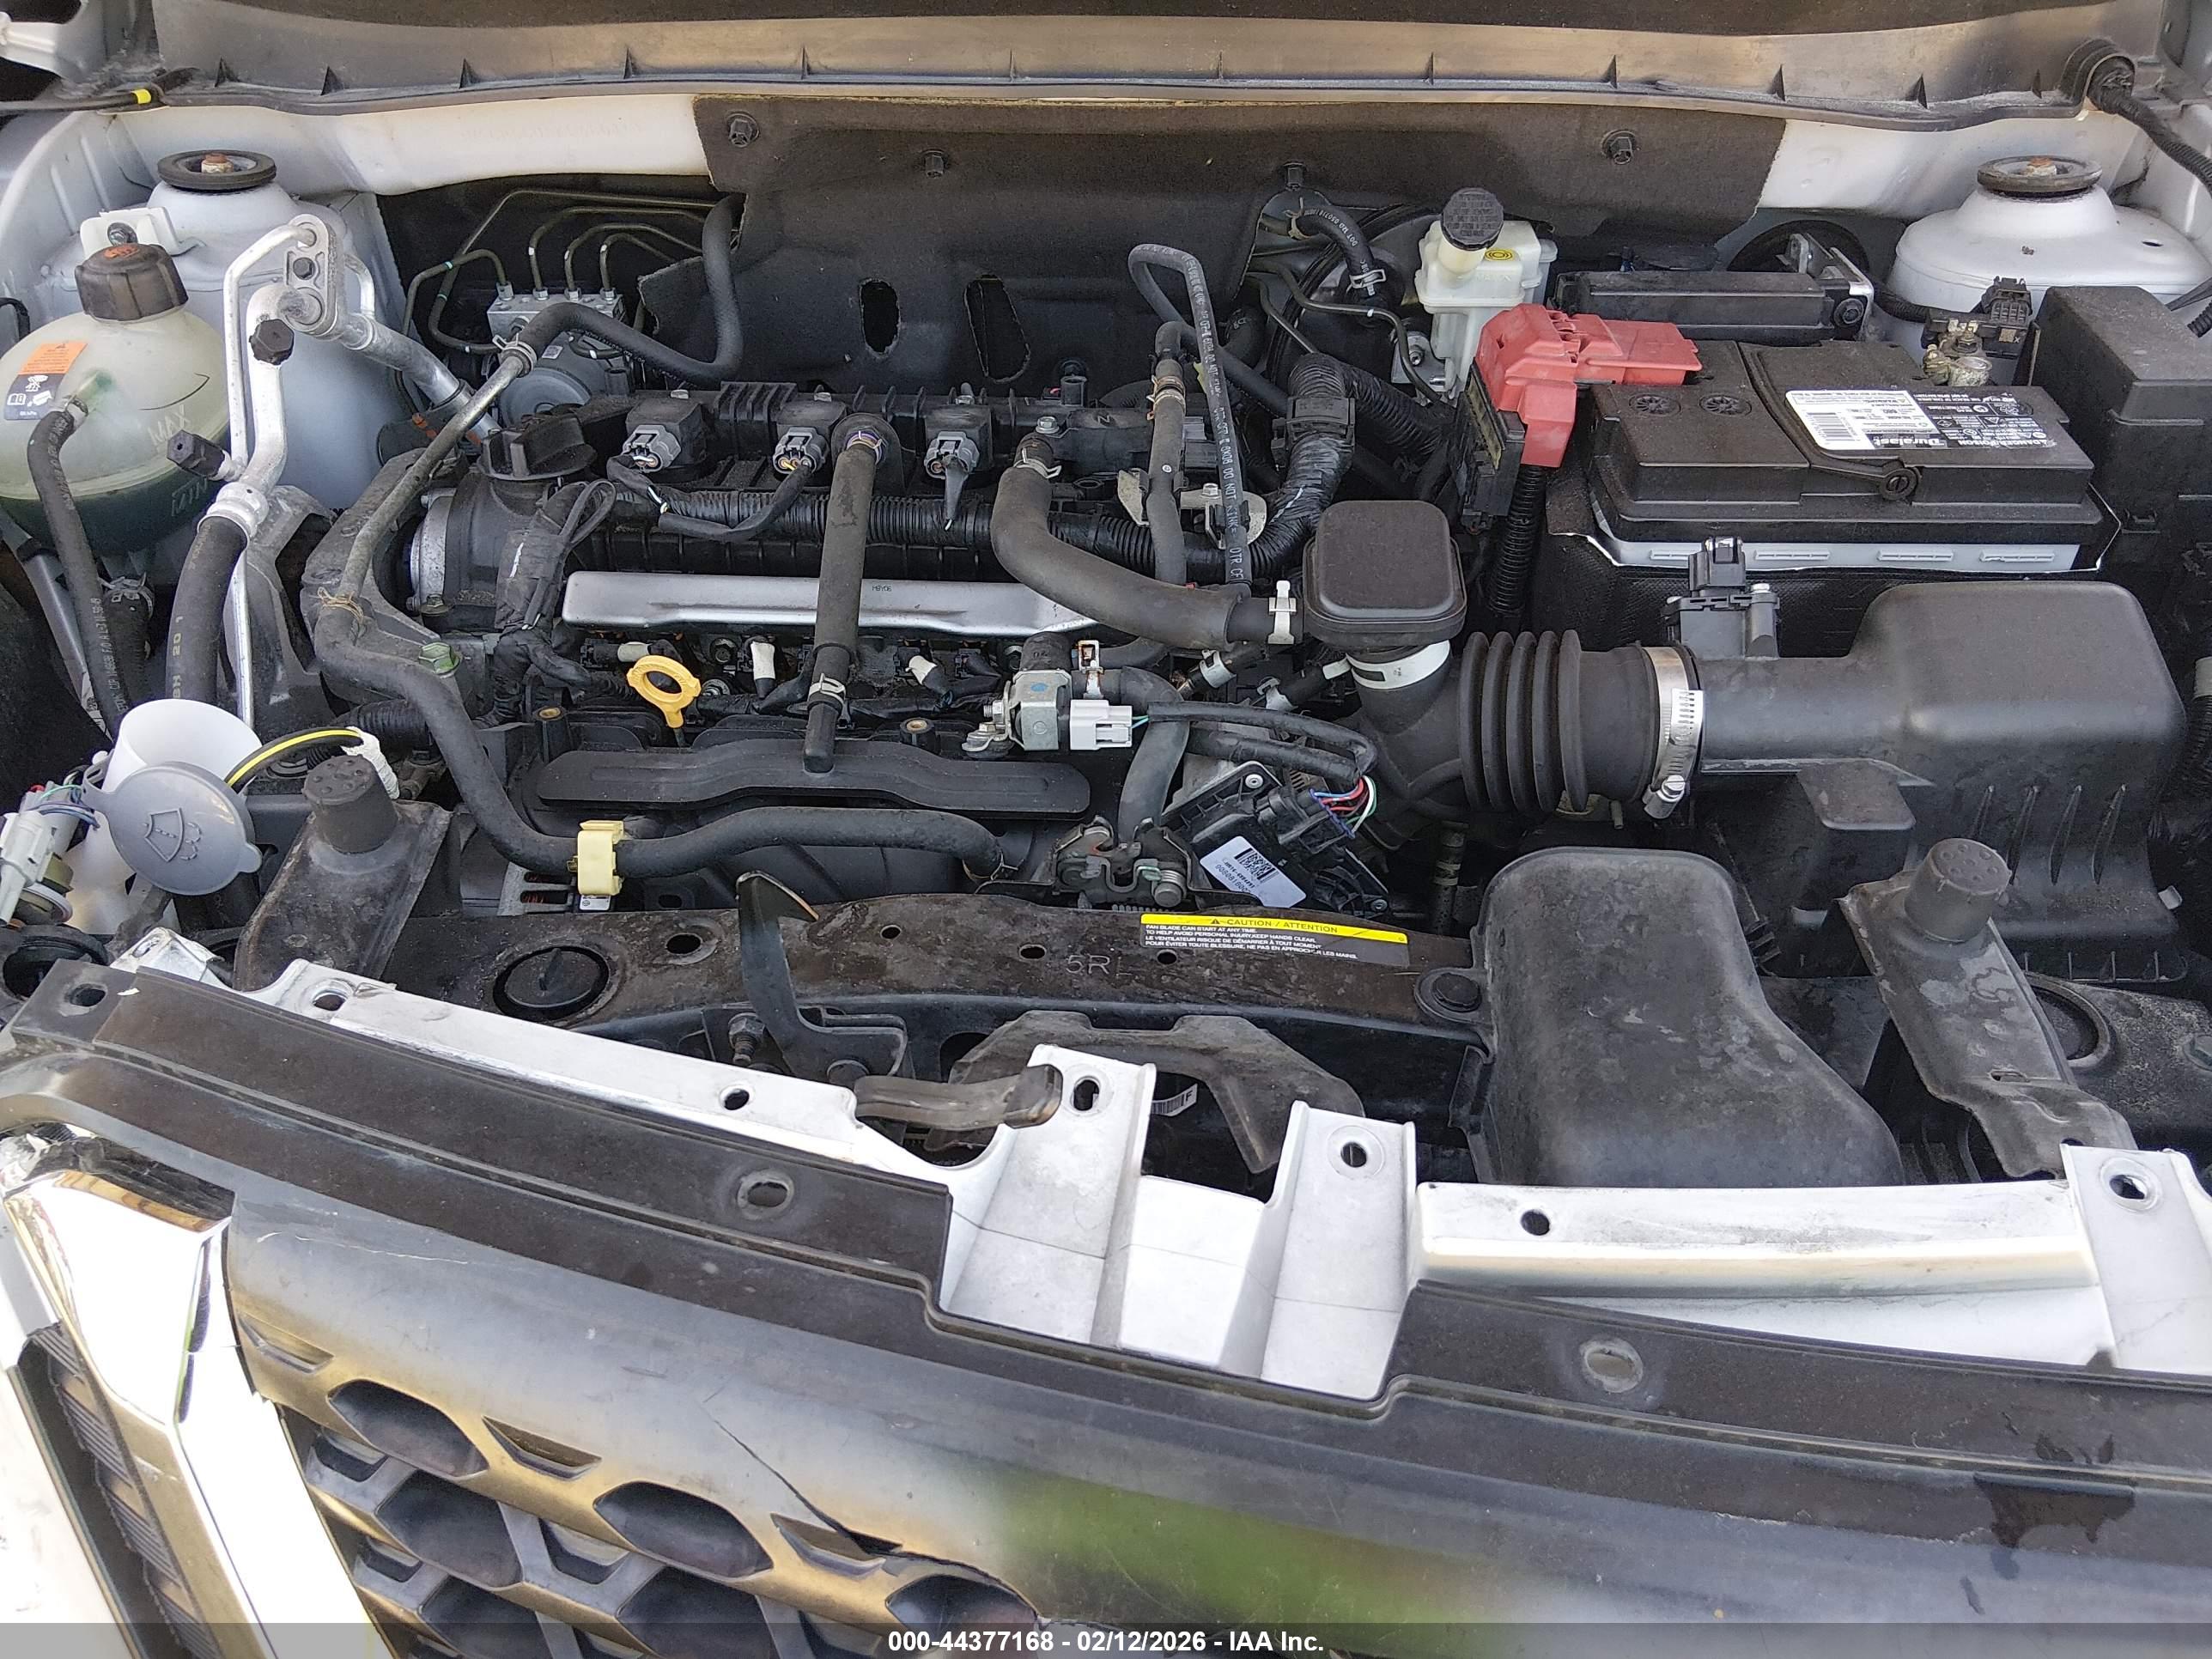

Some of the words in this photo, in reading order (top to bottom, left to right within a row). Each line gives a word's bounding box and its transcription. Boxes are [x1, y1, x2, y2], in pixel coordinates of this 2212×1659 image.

[1874, 436, 1944, 447] Duralast
[1225, 483, 1237, 500] NOT
[1284, 921, 1338, 933] ATTENTION
[1186, 1090, 1193, 1102] F
